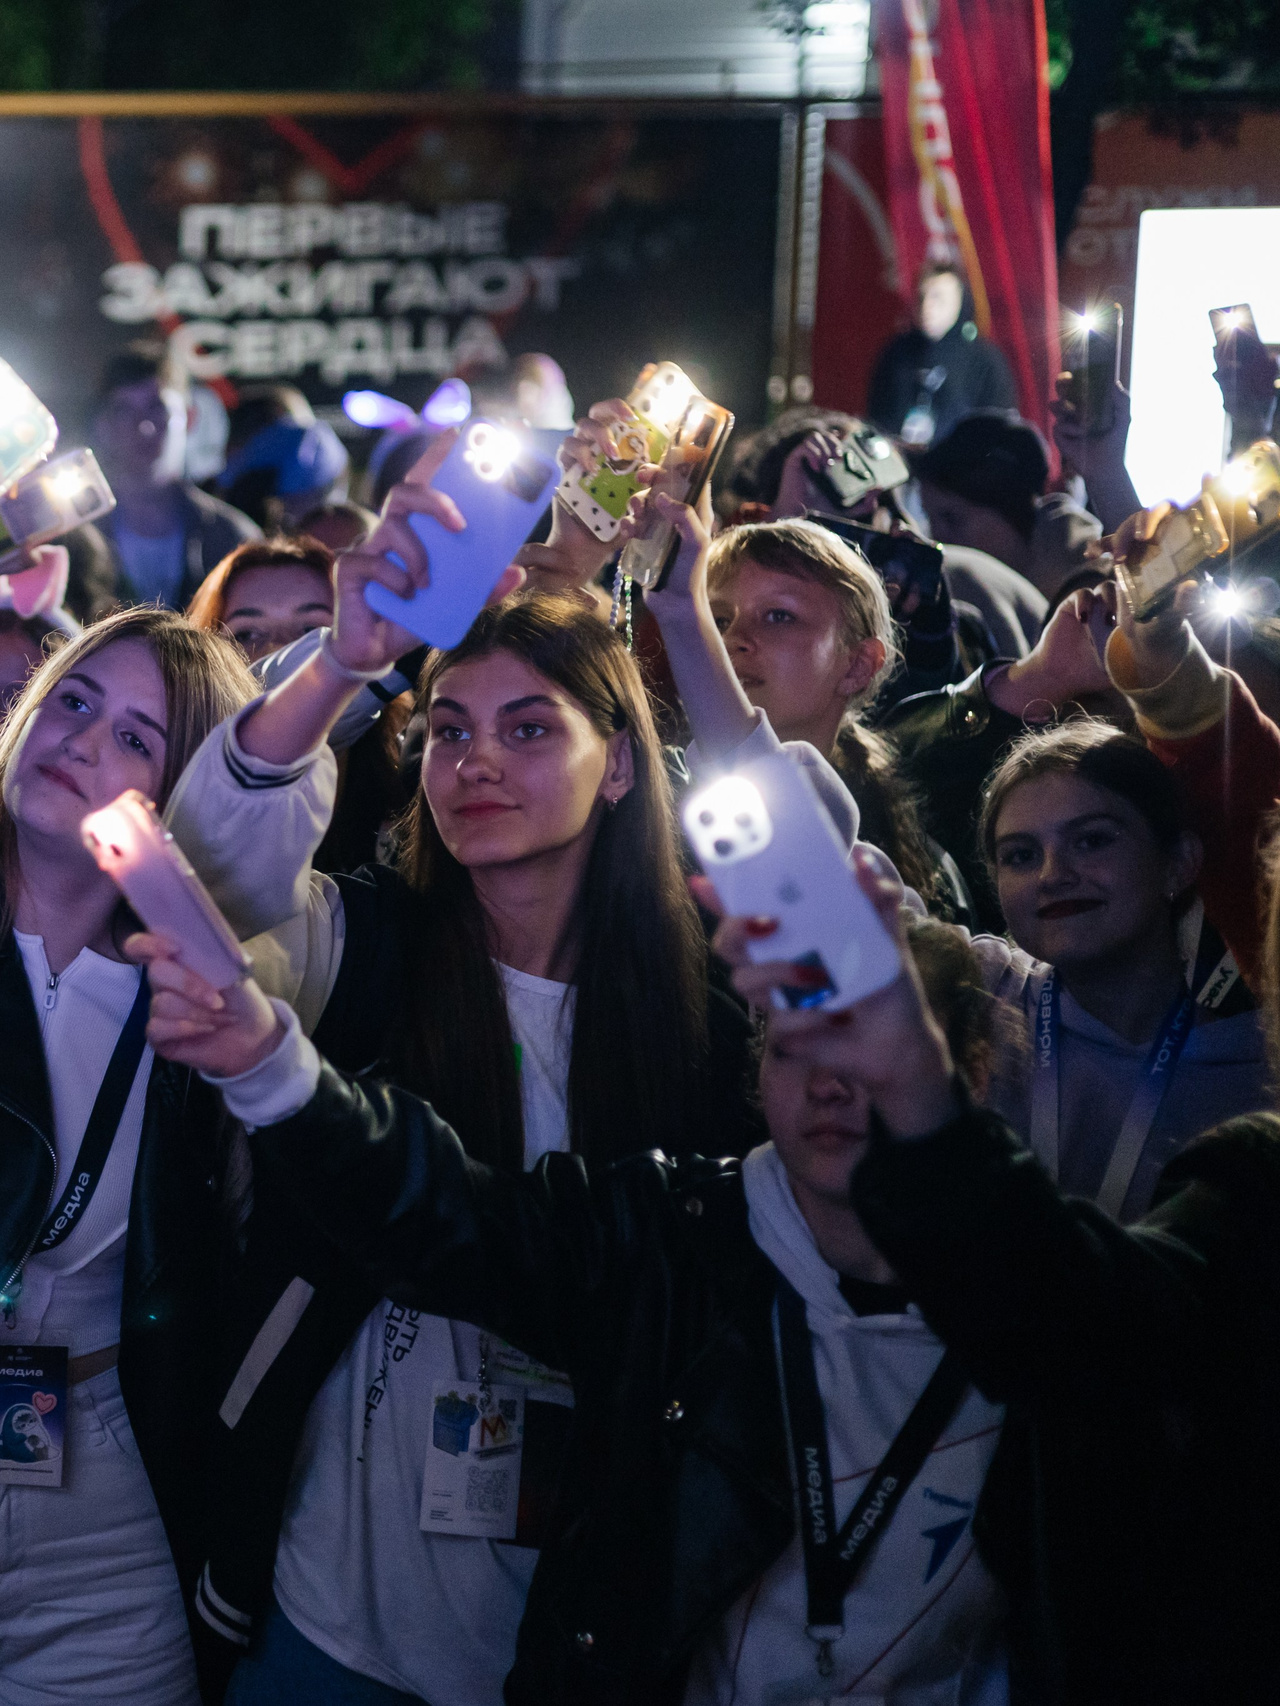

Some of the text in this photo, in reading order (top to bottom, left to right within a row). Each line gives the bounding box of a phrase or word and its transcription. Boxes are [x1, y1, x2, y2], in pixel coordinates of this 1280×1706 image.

[177, 201, 508, 260] ПЕРВЫЕ
[99, 255, 578, 324] ЗАЖИГАЮТ
[167, 317, 507, 385] СЕРДЦА
